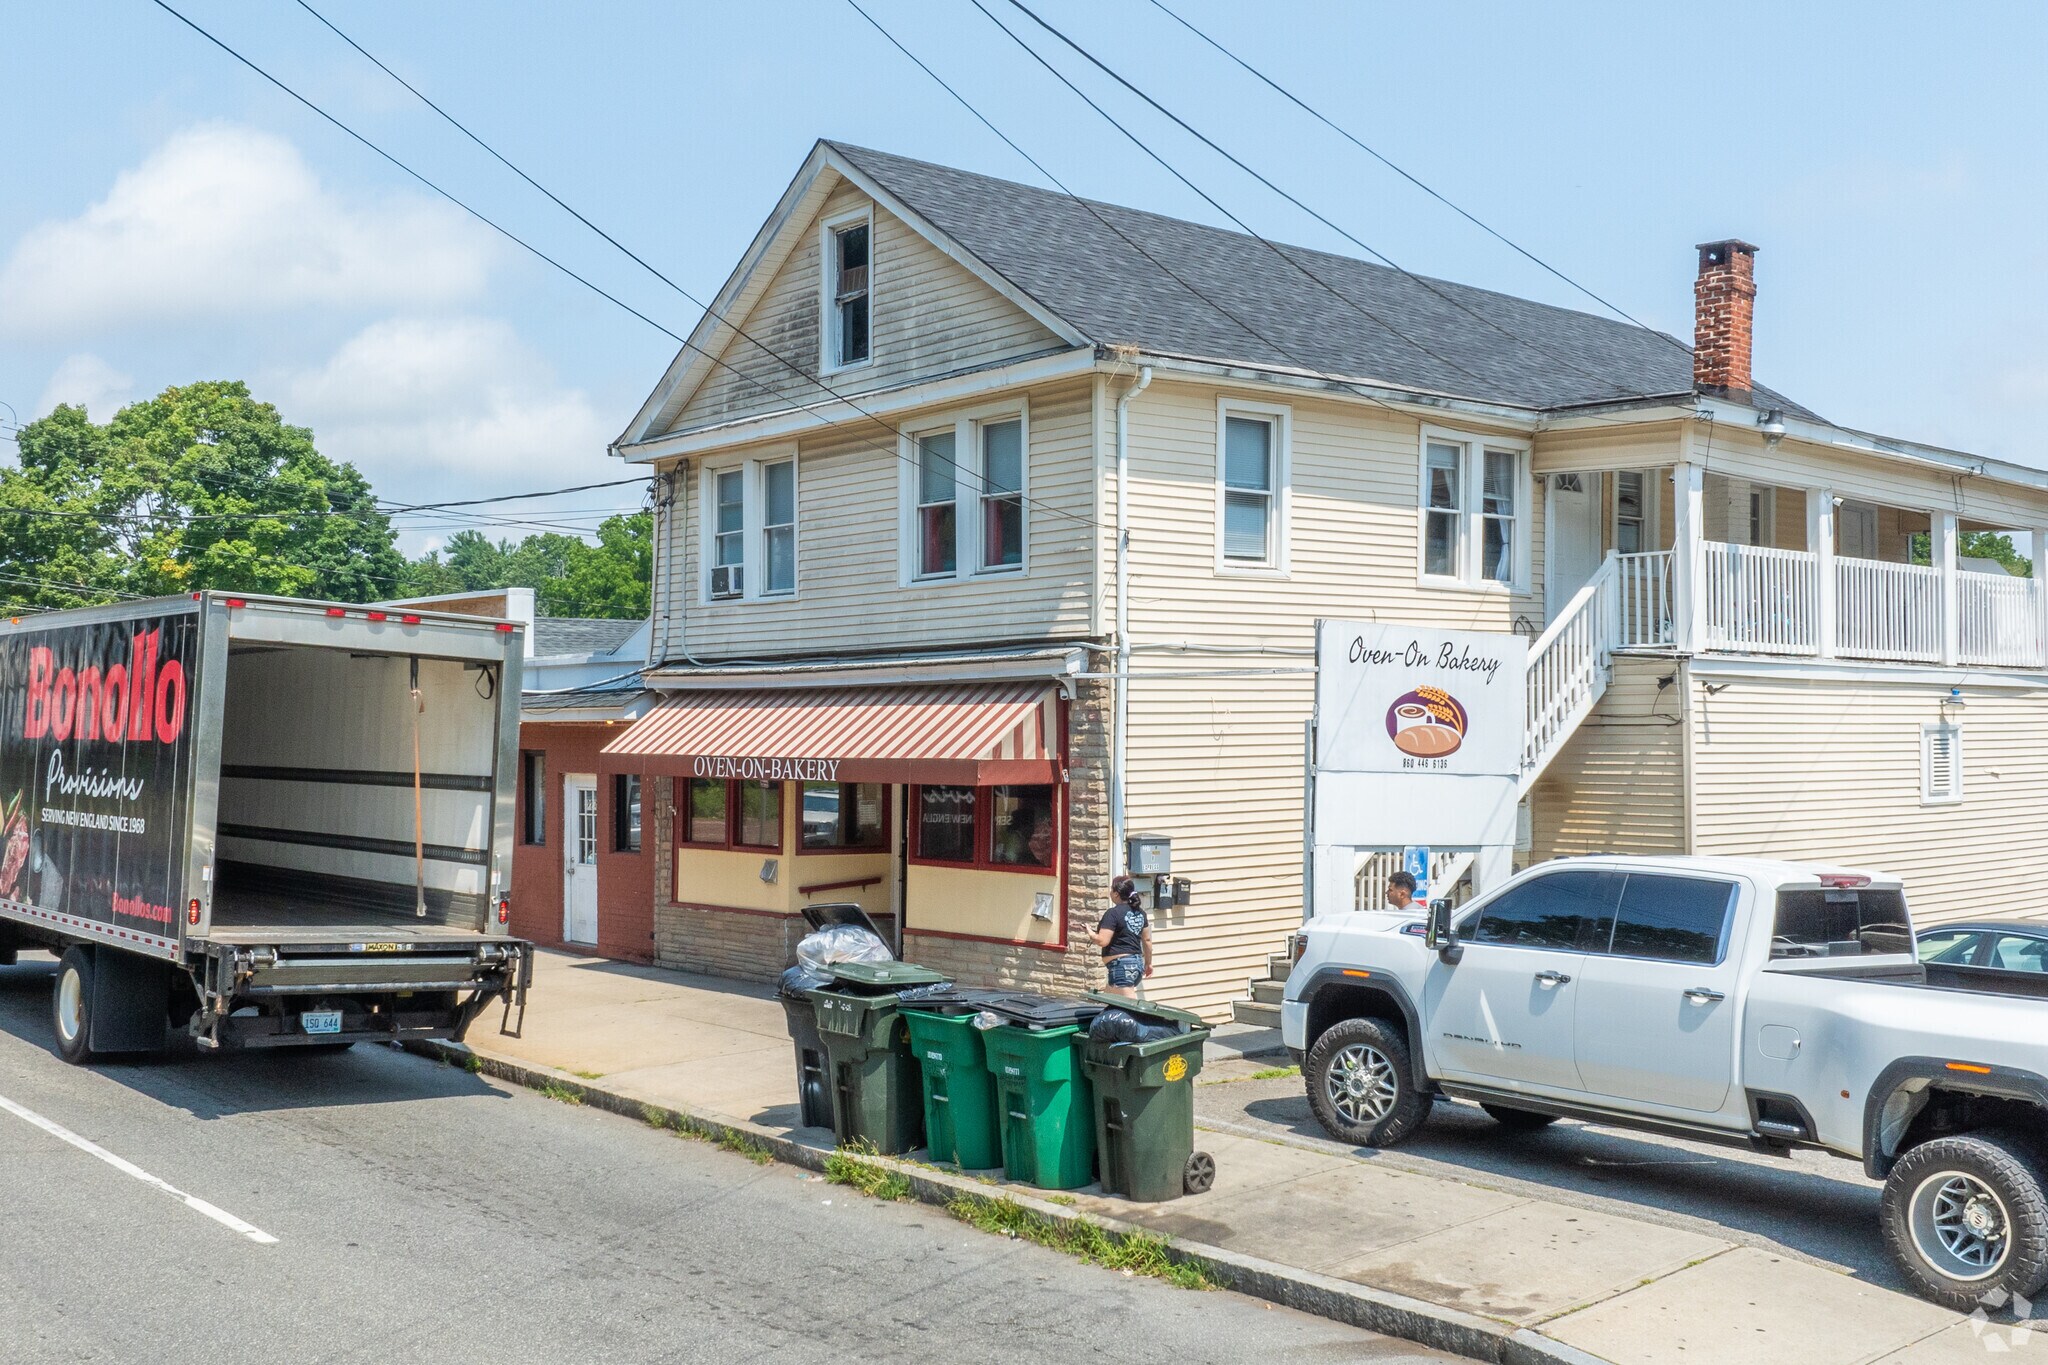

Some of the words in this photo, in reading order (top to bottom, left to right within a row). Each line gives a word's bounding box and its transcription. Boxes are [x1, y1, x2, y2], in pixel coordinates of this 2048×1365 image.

[1349, 635, 1431, 669] Oven-On
[1436, 641, 1502, 685] Bakery
[24, 628, 186, 744] Bonollo
[46, 749, 144, 803] Provisions
[694, 756, 841, 782] OVEN-ON-BAKERY
[1403, 758, 1414, 768] 860
[1418, 758, 1428, 768] 446
[1433, 759, 1447, 769] 6136
[42, 808, 65, 824] SERVING
[65, 811, 80, 826] NEW
[80, 812, 109, 830] ENGLAND
[109, 815, 128, 832] SINCE
[129, 817, 145, 834] 1968
[112, 892, 172, 923] Bonollos.com
[324, 1017, 338, 1028] 644
